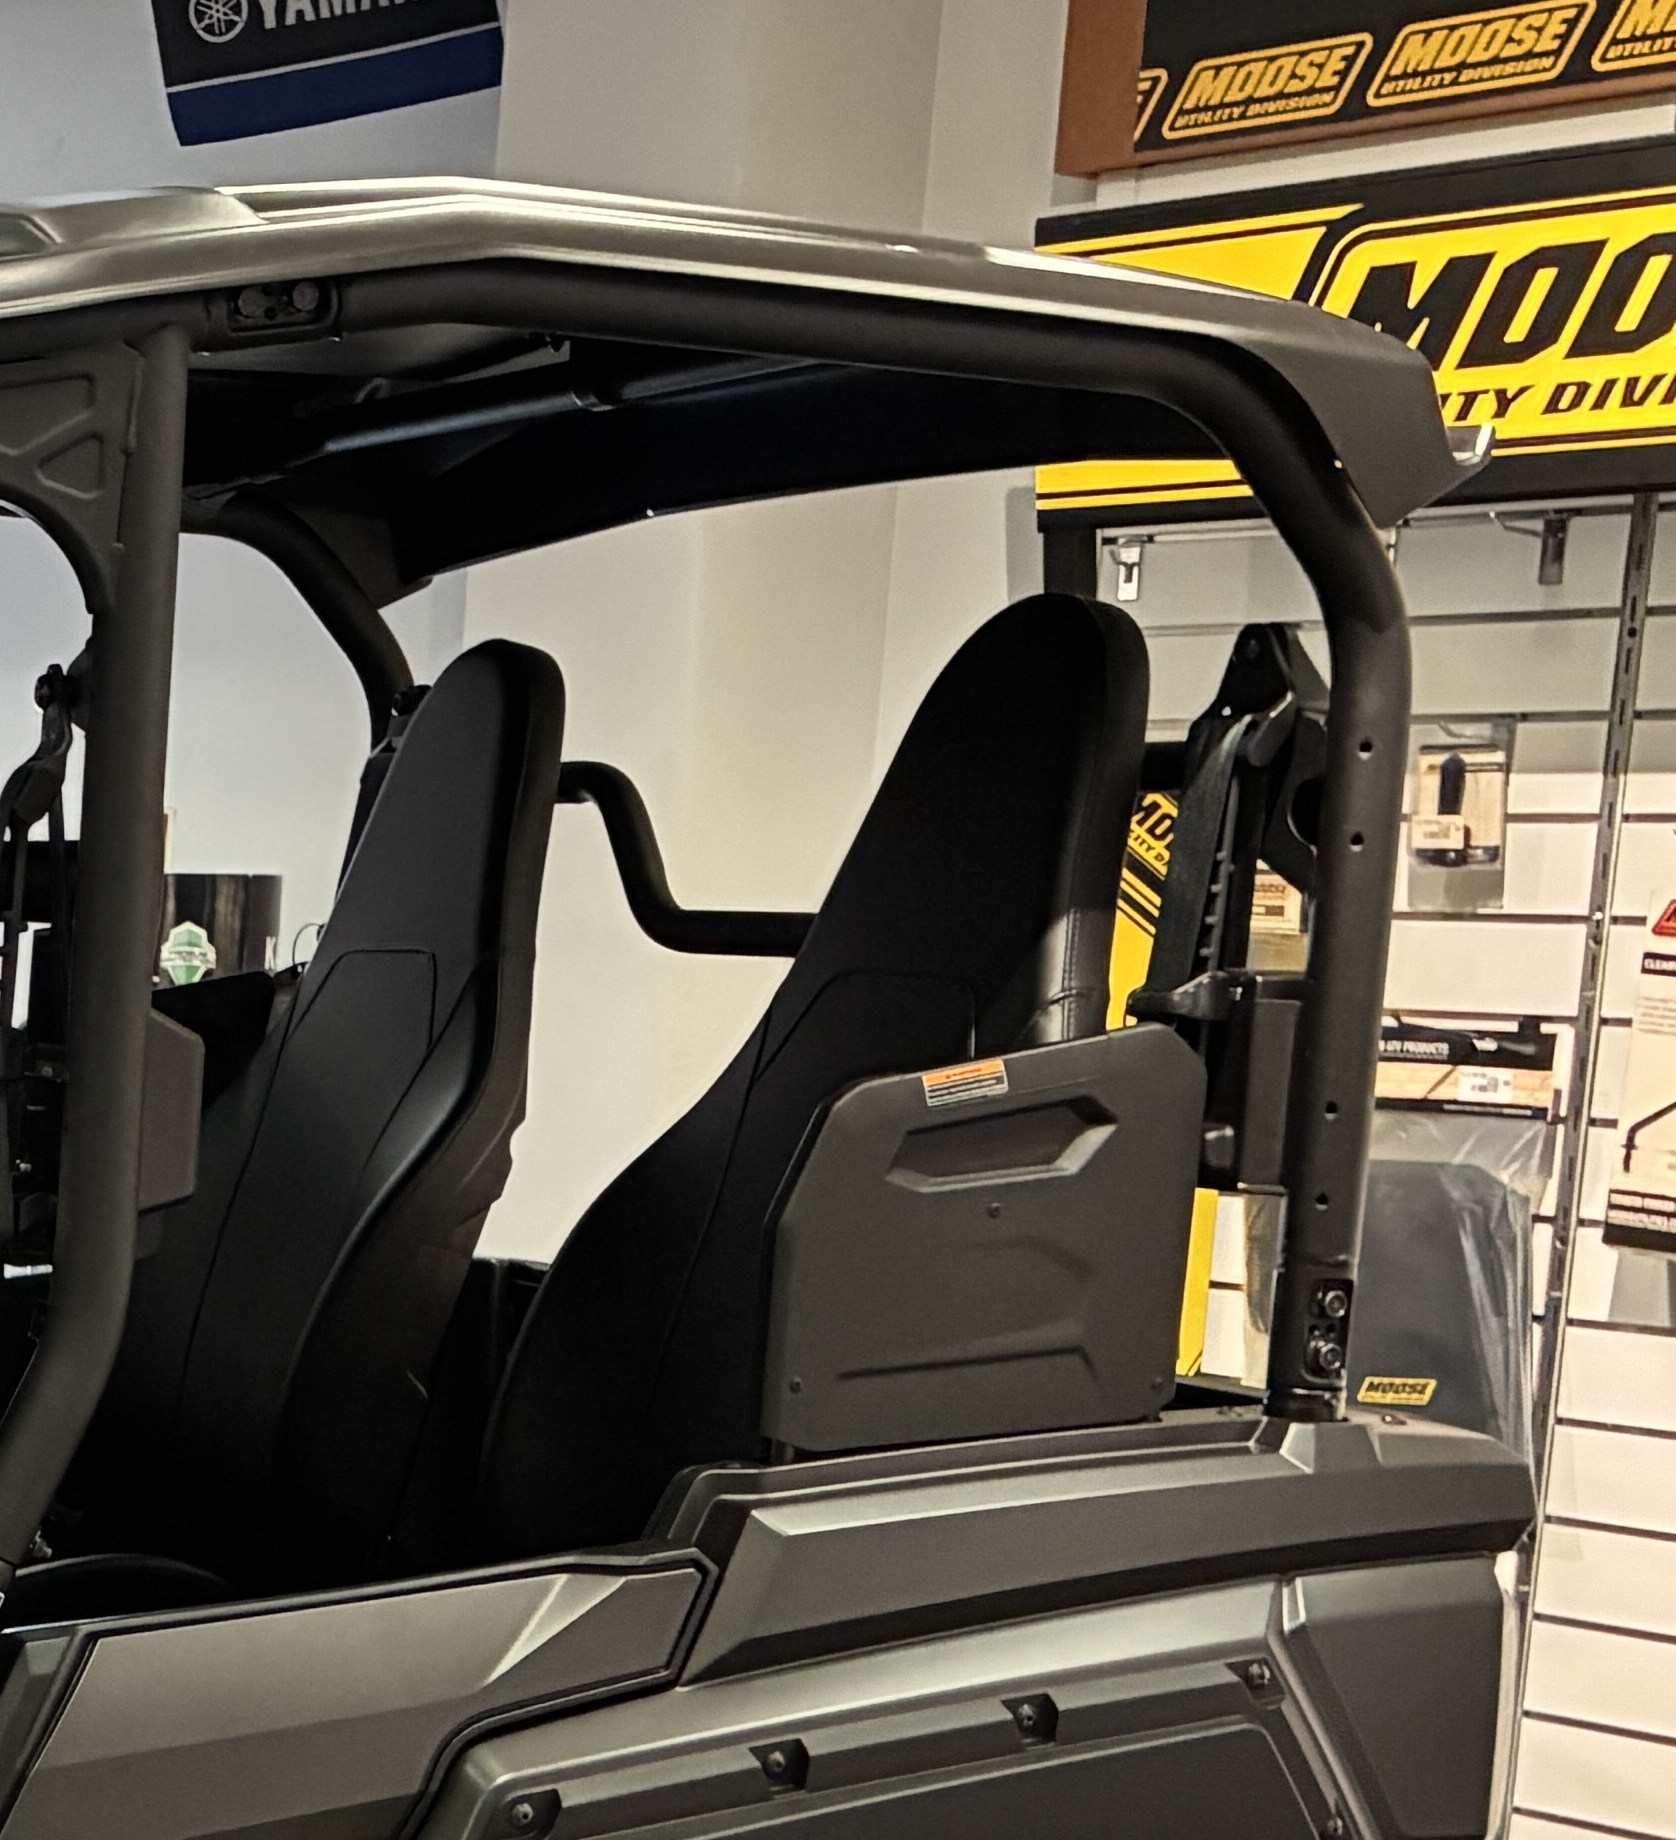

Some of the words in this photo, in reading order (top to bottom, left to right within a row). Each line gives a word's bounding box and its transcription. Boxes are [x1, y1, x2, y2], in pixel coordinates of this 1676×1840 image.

[1389, 7, 1581, 77] MOOSE
[1183, 45, 1357, 109] MOOSE
[1380, 71, 1459, 95] UTILITY
[1458, 55, 1555, 83] DIVISION
[1174, 104, 1245, 129] UTILITY
[1245, 91, 1336, 118] DIVISION
